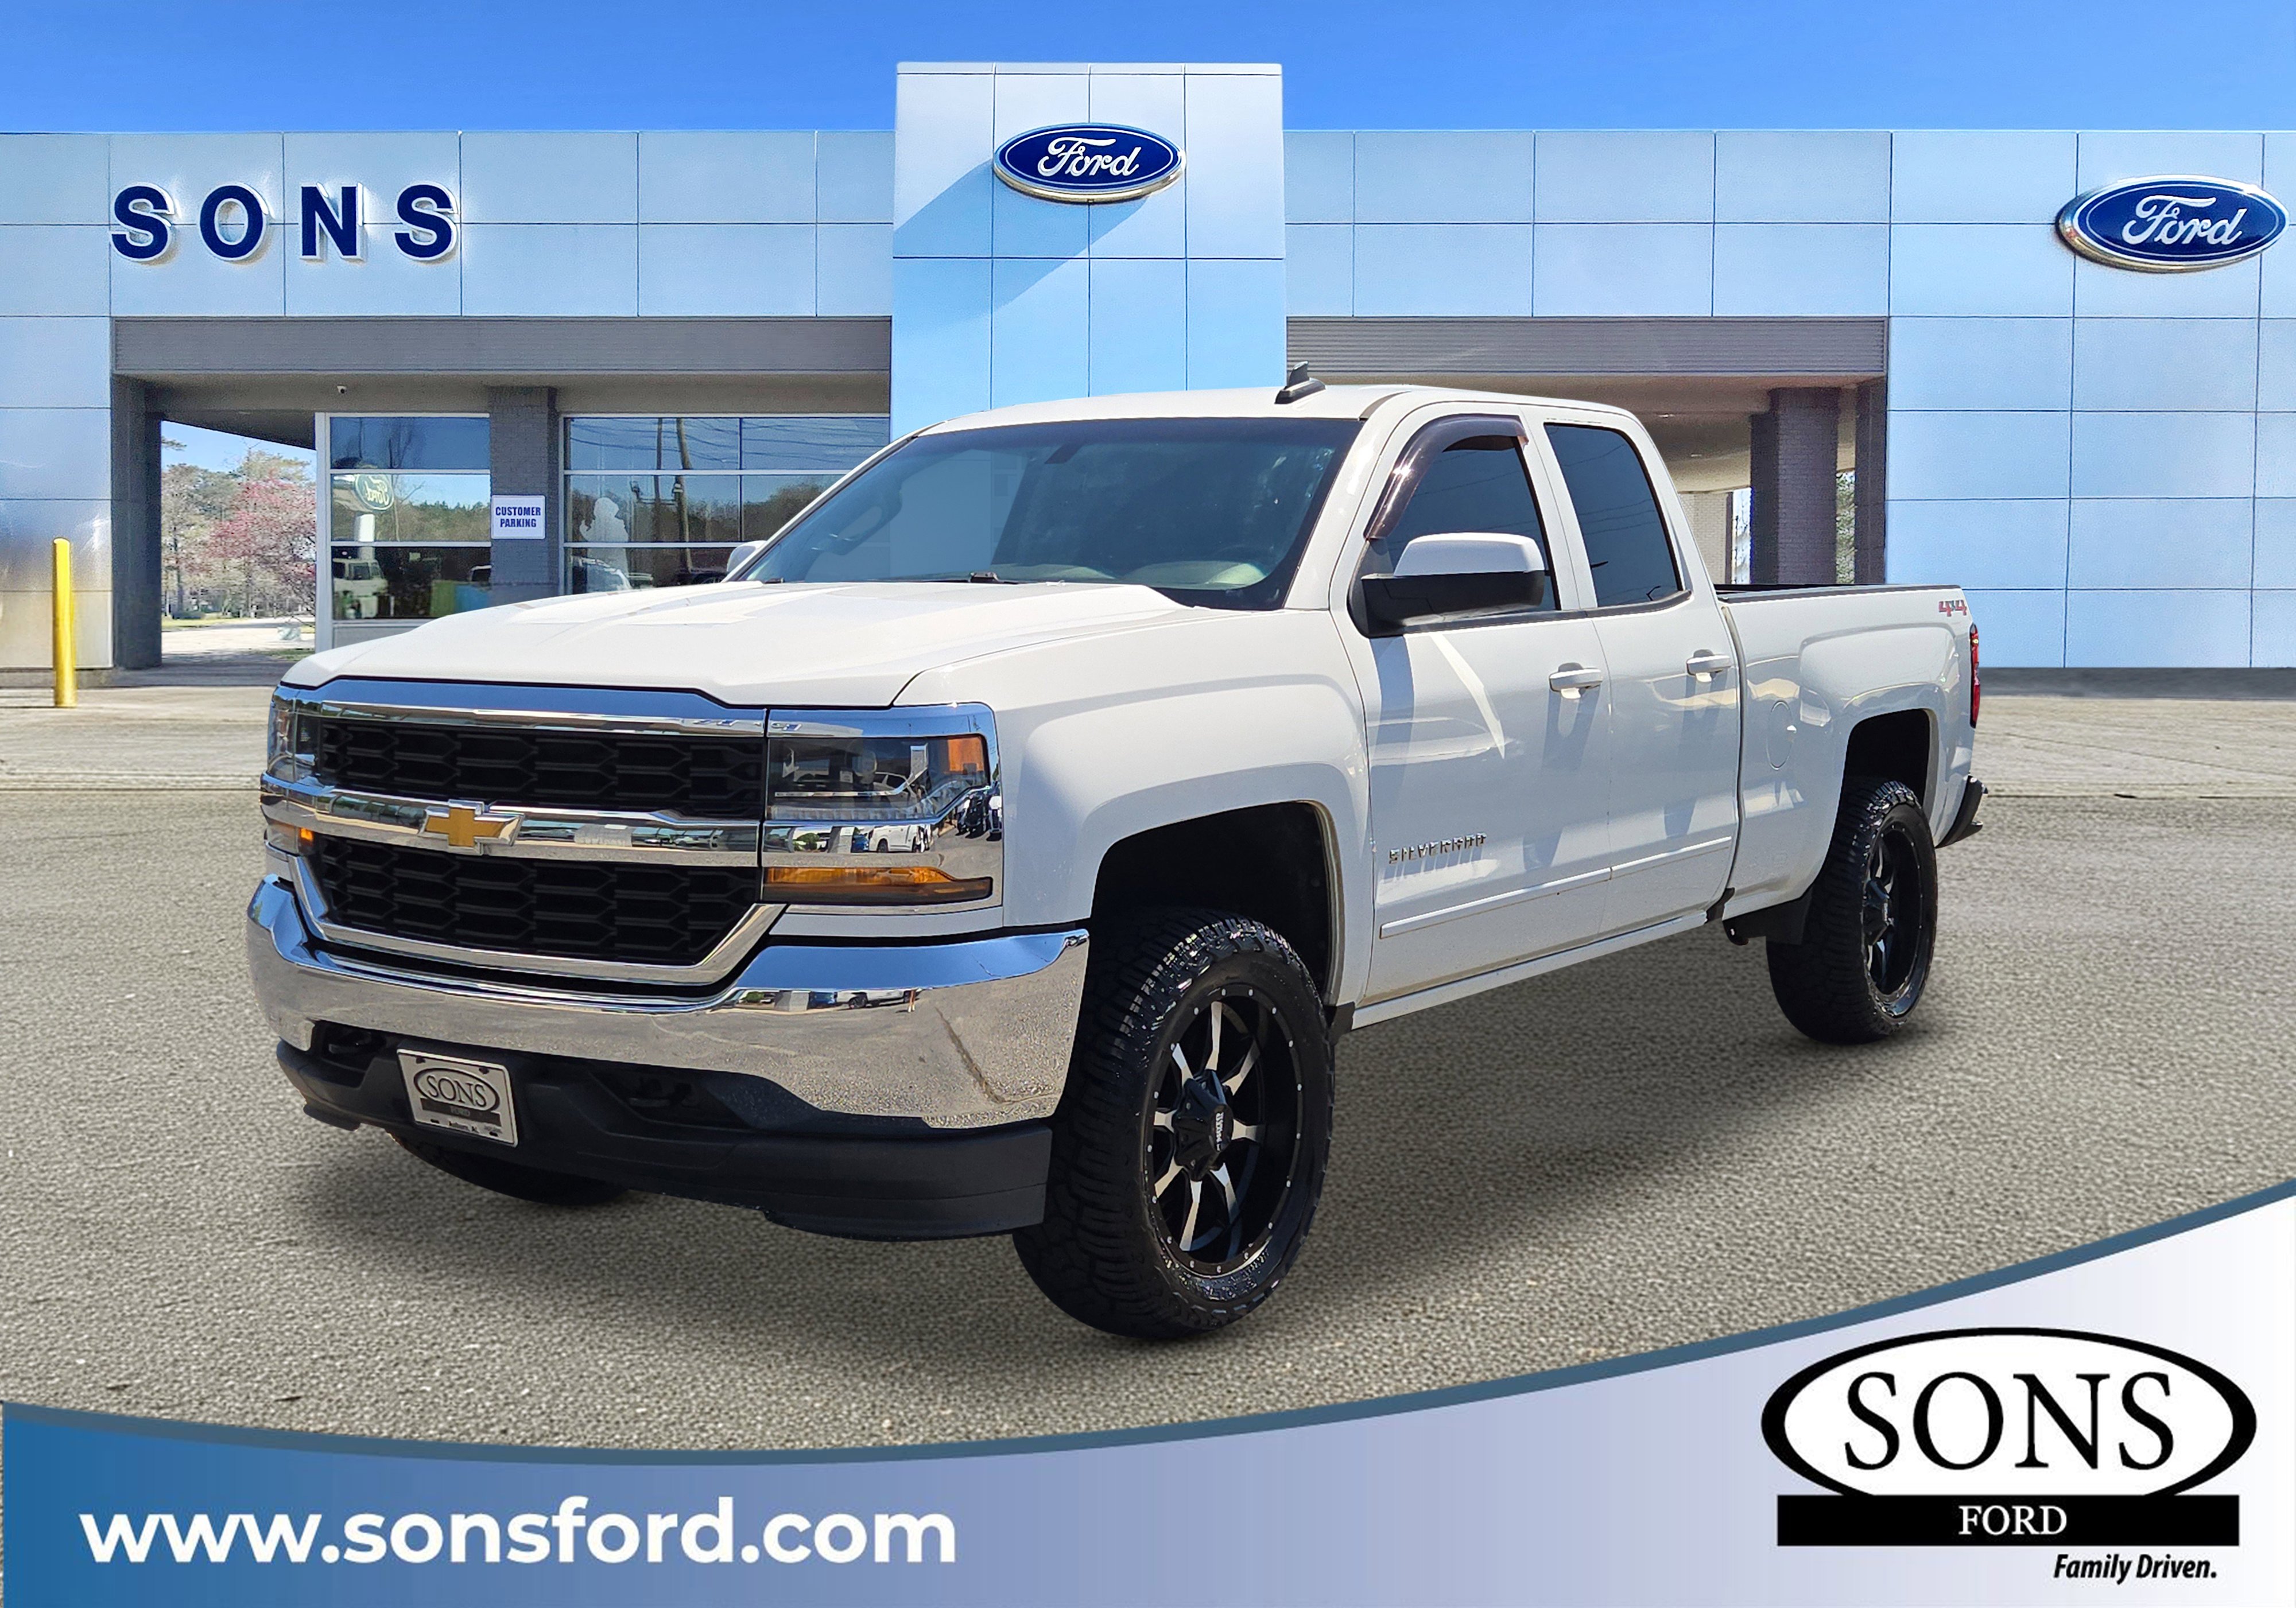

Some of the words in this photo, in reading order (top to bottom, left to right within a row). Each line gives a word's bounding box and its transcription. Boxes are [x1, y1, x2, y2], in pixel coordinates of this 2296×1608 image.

[1037, 136, 1142, 177] Ford
[111, 183, 457, 260] SONS
[2122, 195, 2247, 245] Ford
[495, 506, 541, 516] CUSTOMER
[500, 518, 537, 527] PARKING
[426, 1075, 487, 1108] SONS
